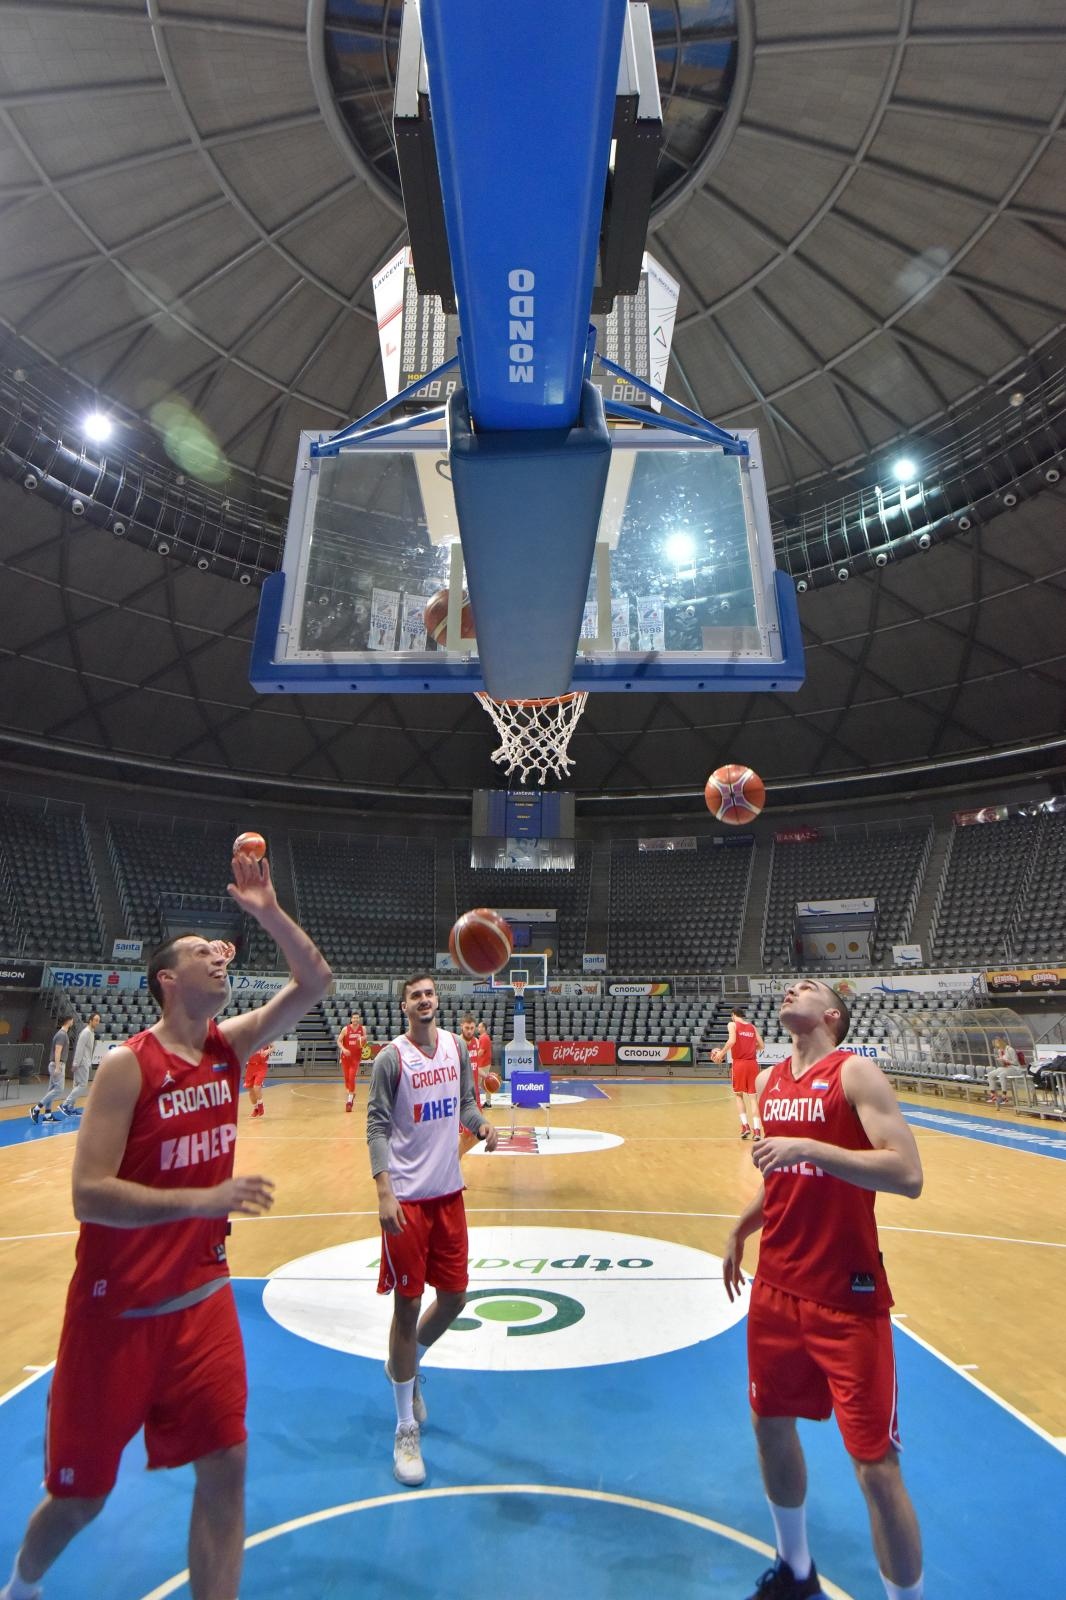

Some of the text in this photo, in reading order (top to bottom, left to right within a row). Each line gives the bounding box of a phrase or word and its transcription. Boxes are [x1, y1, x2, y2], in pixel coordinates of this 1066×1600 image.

[508, 269, 535, 383] MONDO
[54, 972, 102, 988] ERSTE
[624, 1049, 661, 1057] CRODUX
[411, 1065, 458, 1090] CROATIA
[516, 1083, 544, 1091] molten
[158, 1079, 232, 1120] CROATIA
[763, 1097, 826, 1122] CROATIA
